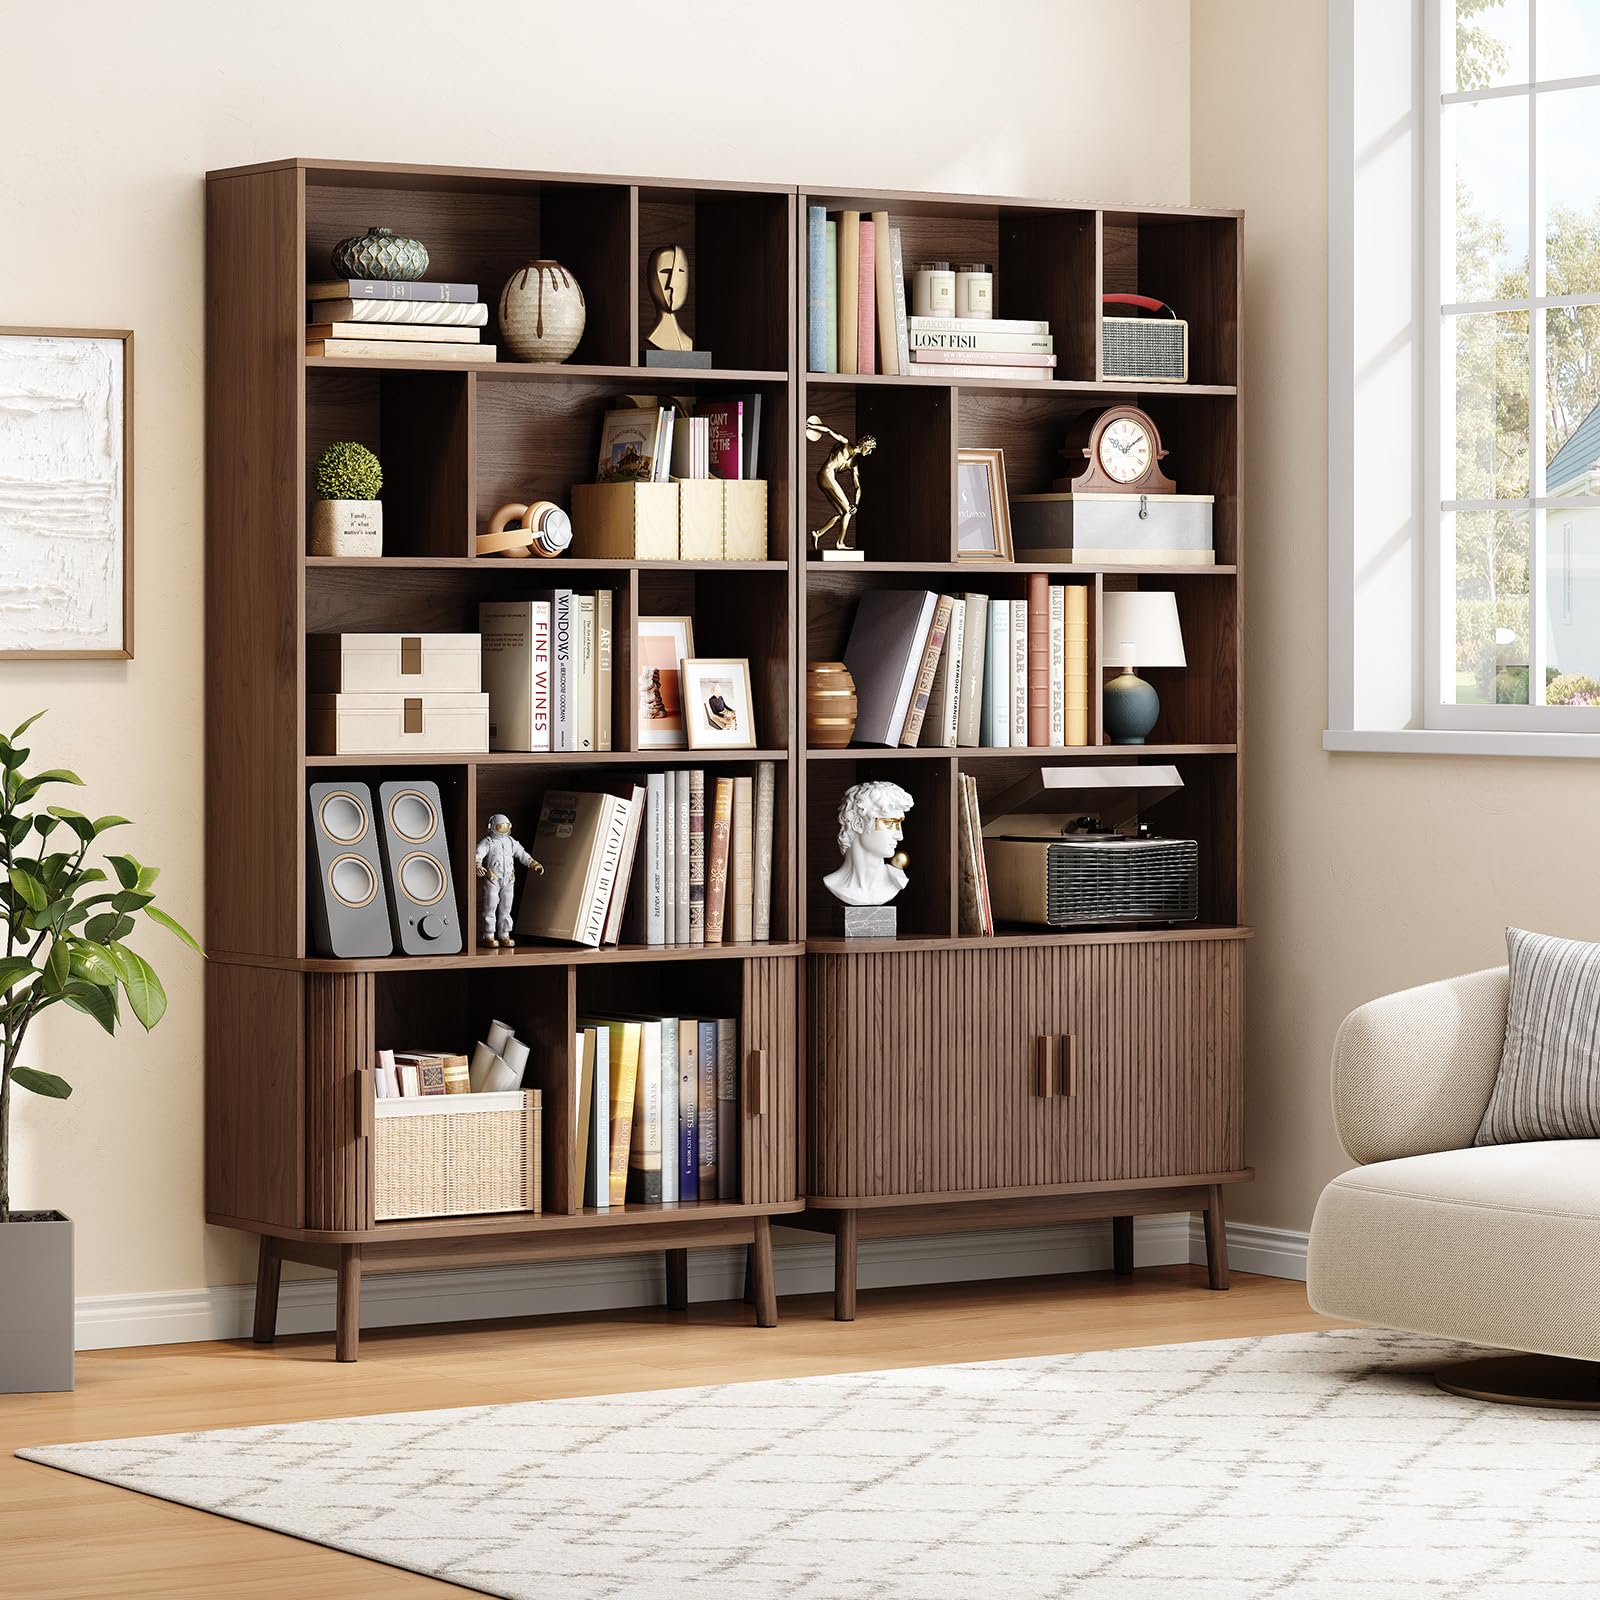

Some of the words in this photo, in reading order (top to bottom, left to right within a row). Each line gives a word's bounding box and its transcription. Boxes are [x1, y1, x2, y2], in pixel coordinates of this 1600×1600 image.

[894, 259, 907, 345] KINFOLK
[915, 333, 946, 347] LOST
[949, 335, 976, 348] FISH
[917, 319, 952, 329] MAKING
[1015, 600, 1025, 633] TOLSTOY
[1052, 586, 1062, 622] TOLSTOY
[535, 622, 547, 663] FINE
[558, 594, 569, 661] WINDOWS
[600, 628, 610, 653] ART
[1016, 638, 1024, 674] WAR
[1053, 627, 1061, 666] WAR
[535, 671, 547, 732] WINES
[559, 694, 567, 722] GOODMAN
[1016, 686, 1024, 735] PEACE
[1053, 680, 1061, 733] PEACE
[705, 1026, 713, 1051] BEATY
[705, 1054, 713, 1073] AND
[705, 1074, 713, 1101] STEVE
[705, 1107, 713, 1120] ON
[620, 1119, 629, 1149] ABOUT
[705, 1123, 713, 1167] VACATION
